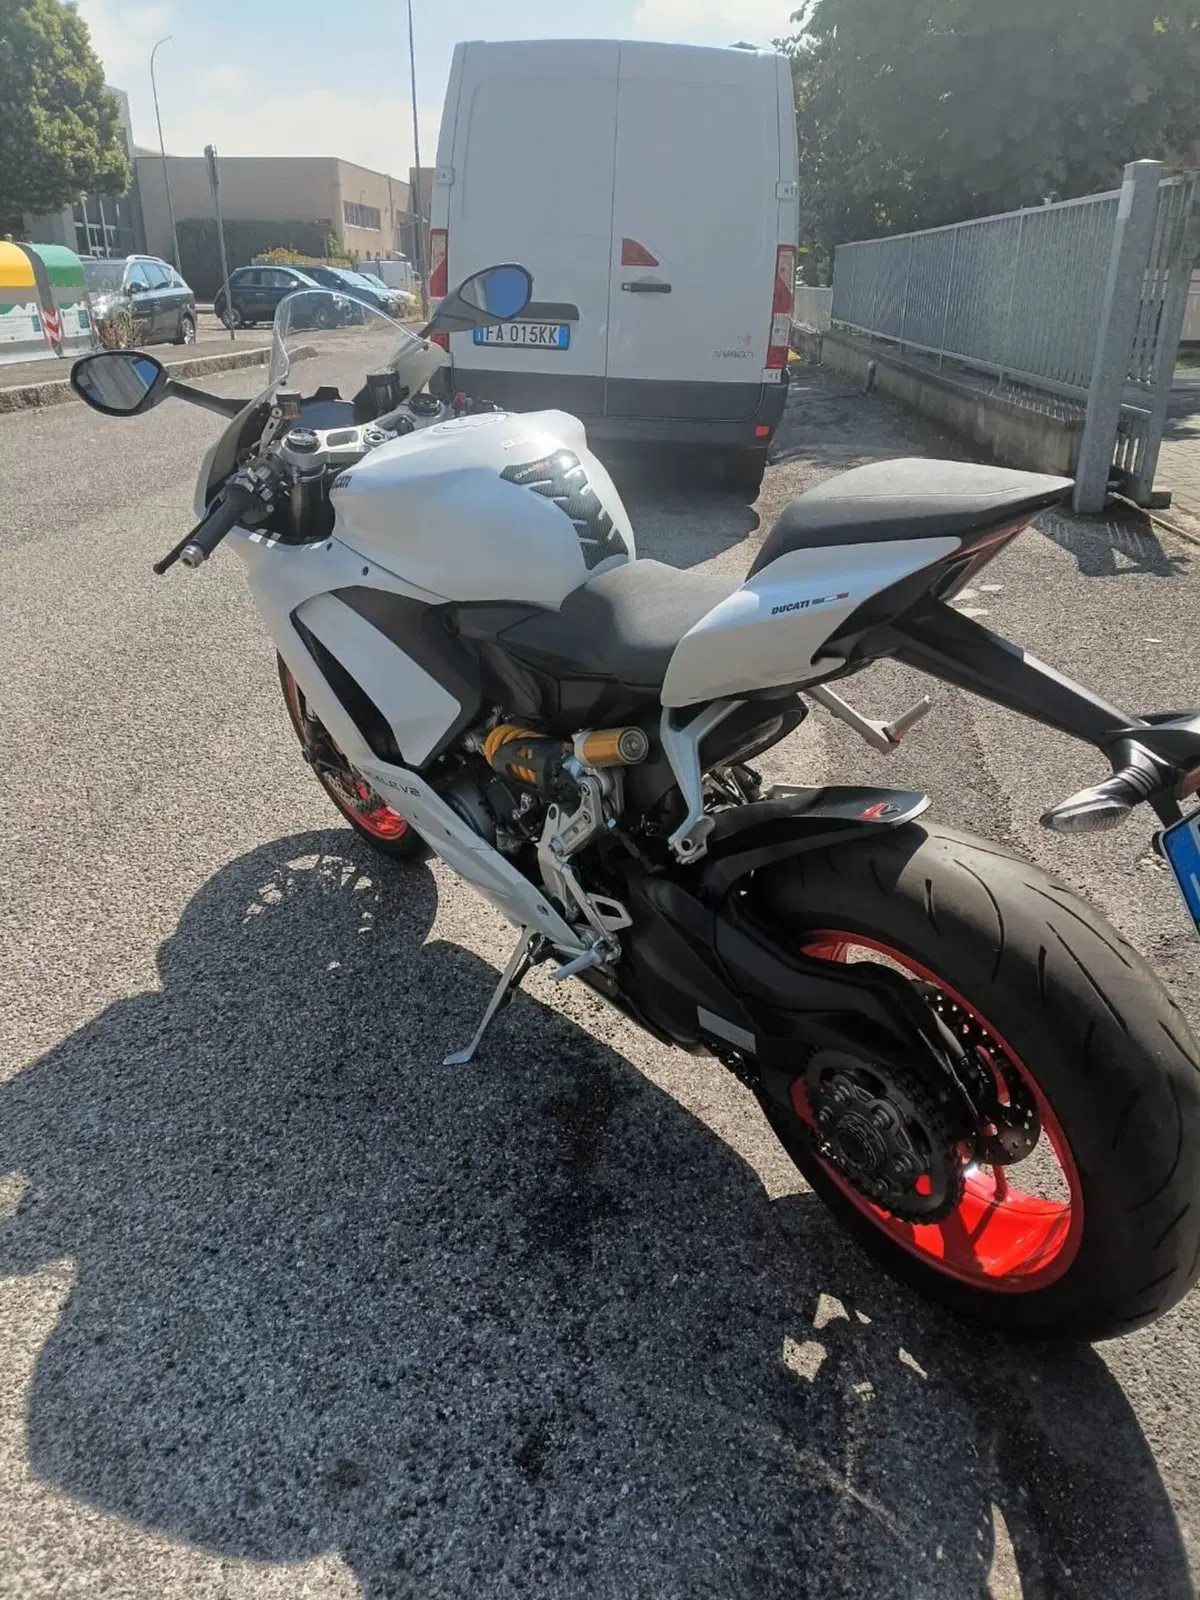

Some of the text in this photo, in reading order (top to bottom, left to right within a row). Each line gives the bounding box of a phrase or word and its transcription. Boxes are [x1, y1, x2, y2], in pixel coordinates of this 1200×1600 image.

[486, 325, 504, 341] FA
[510, 324, 557, 344] 015KK
[771, 599, 811, 615] DUCATI
